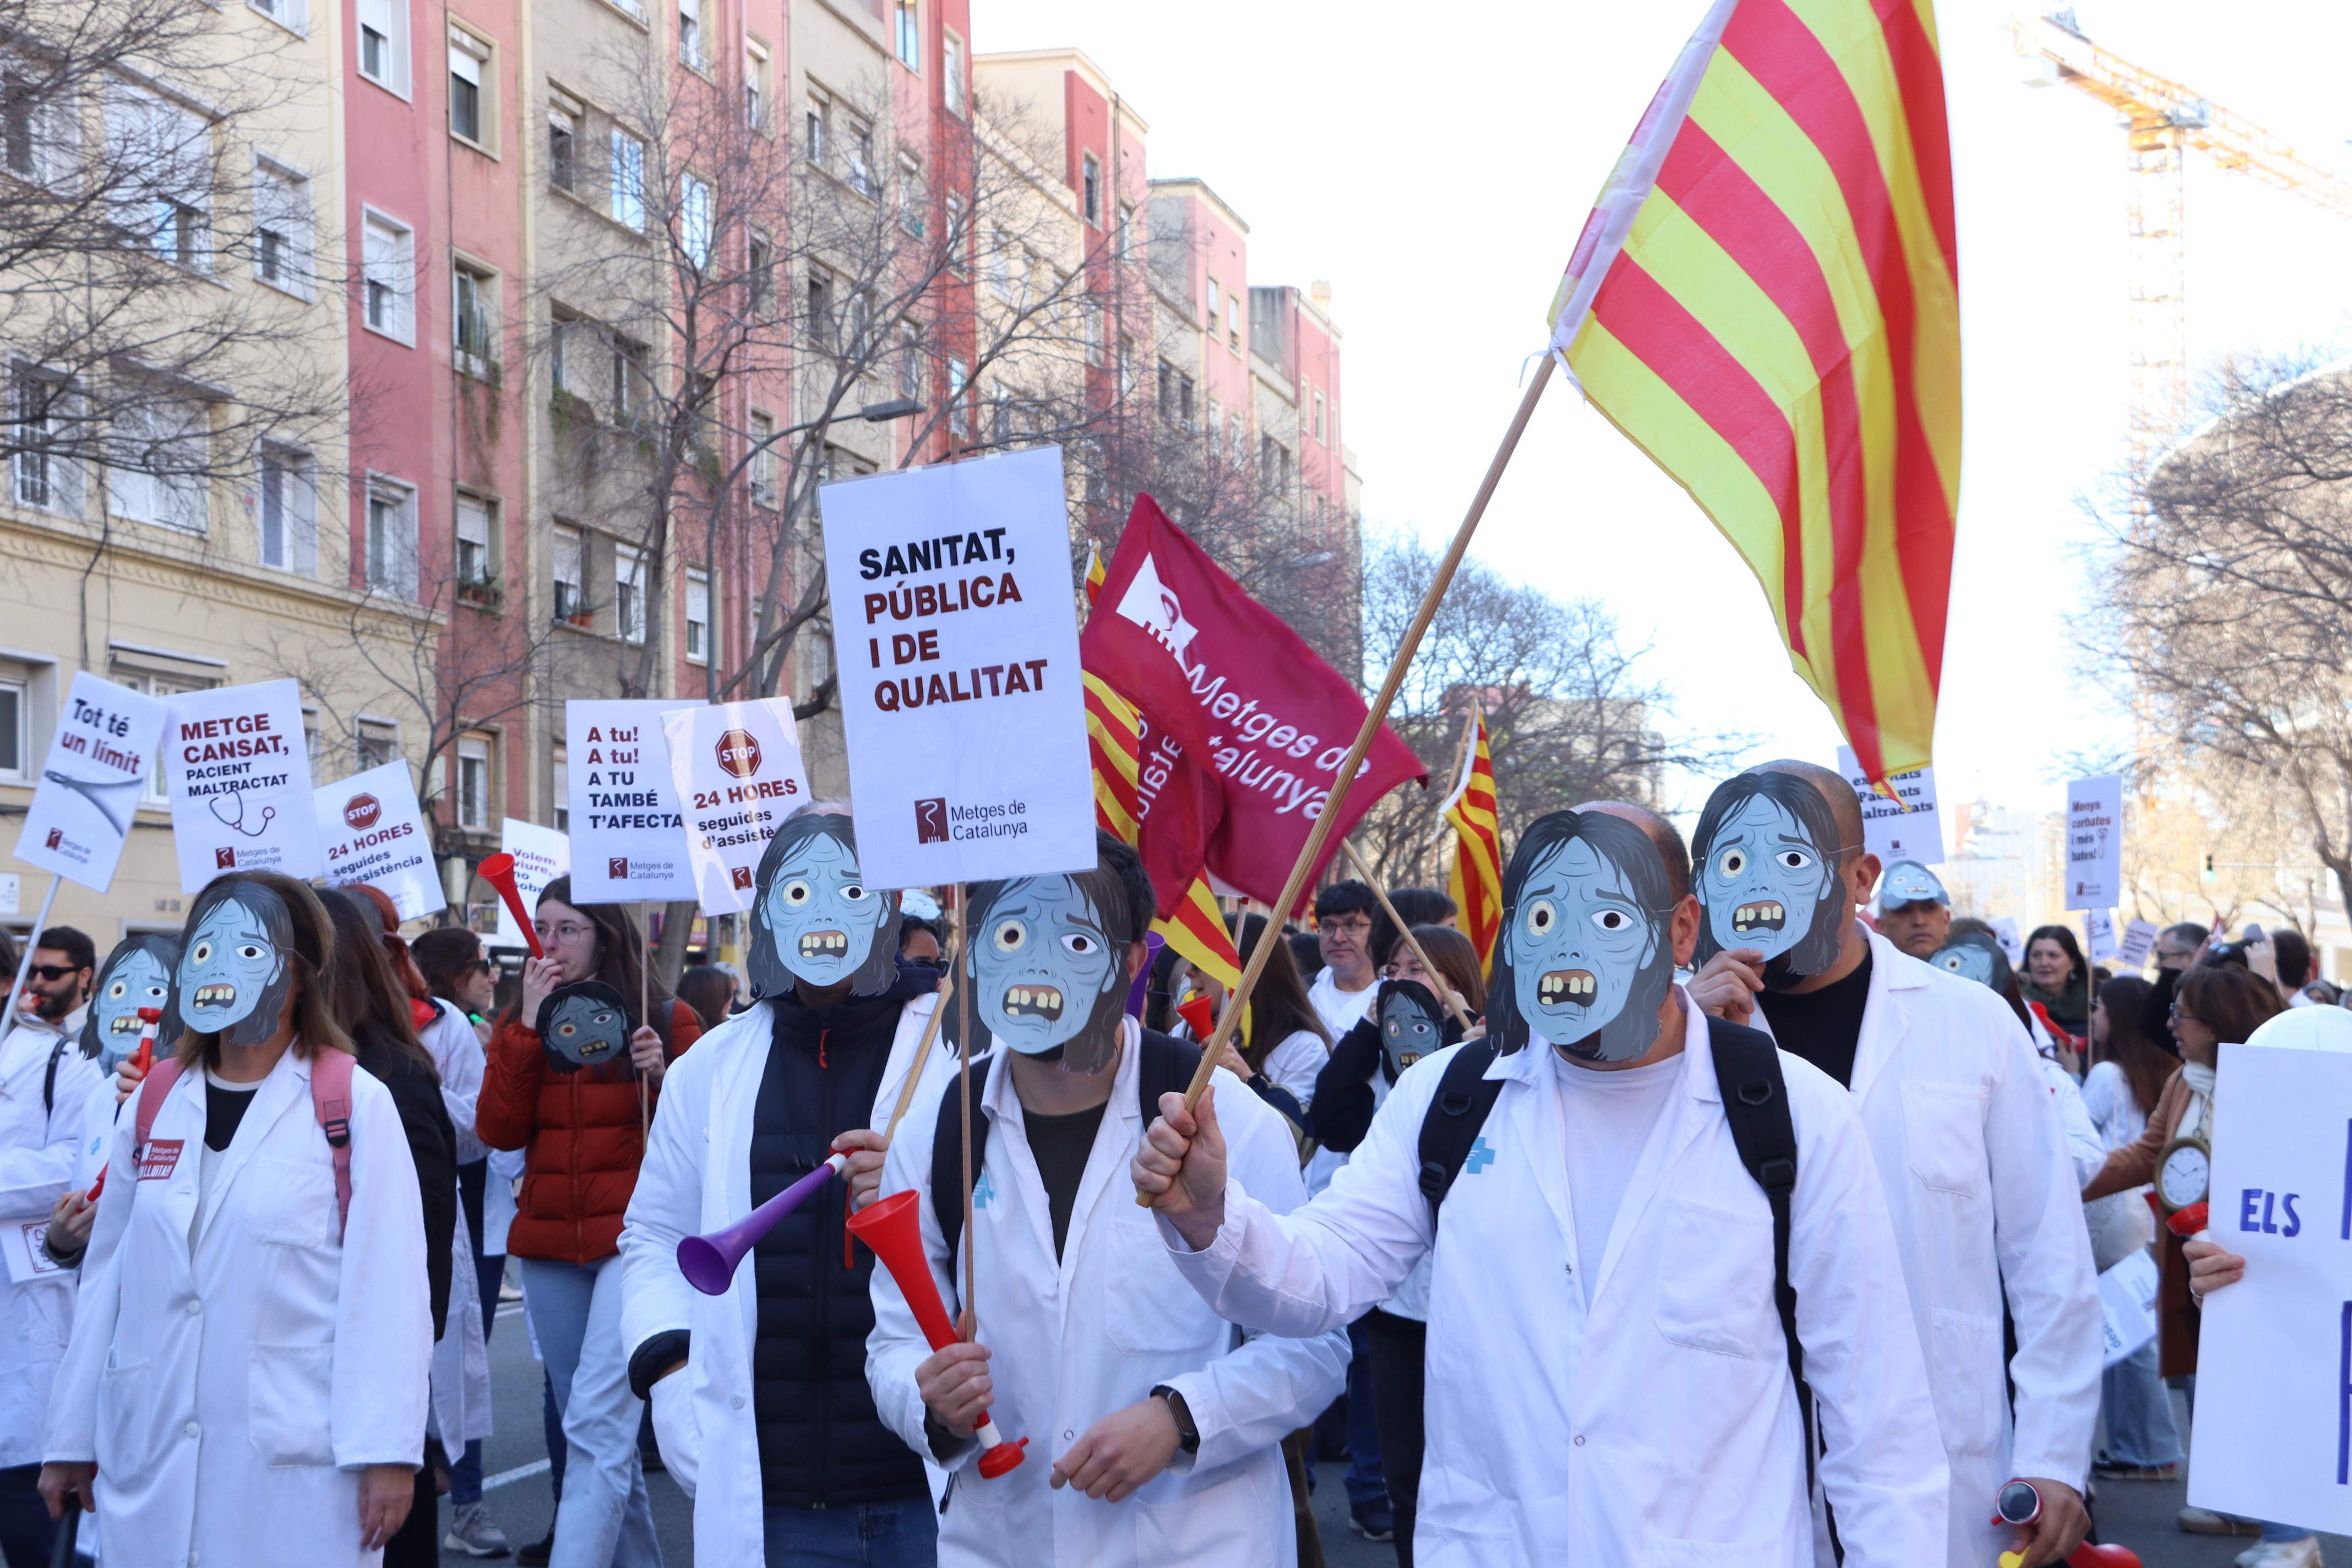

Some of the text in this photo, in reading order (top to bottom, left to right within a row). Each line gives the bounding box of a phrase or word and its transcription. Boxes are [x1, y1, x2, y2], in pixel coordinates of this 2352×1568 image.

[859, 527, 1015, 580] SANITAT,
[863, 571, 1022, 624] PÚBLICA
[869, 629, 940, 668] I DE
[874, 658, 1048, 712] QUALITAT
[72, 698, 131, 737] Tot té
[1188, 663, 1320, 758] Metges
[181, 713, 270, 741] METGE
[587, 726, 639, 742] A tu!
[61, 731, 141, 775] un límit
[183, 735, 289, 764] CANSAT,
[587, 748, 639, 764] A tu!
[722, 746, 756, 762] STOP
[186, 762, 252, 780] PACIENT
[588, 771, 634, 786] A TU
[188, 774, 288, 797] MALTRACTAT
[693, 778, 798, 809] 24 HORES
[589, 789, 658, 808] TAMBÉ
[2072, 800, 2100, 813] Menys
[348, 803, 376, 820] STOP
[698, 810, 772, 831] seguides
[951, 799, 1026, 822] Metges de
[589, 814, 683, 829] T'AFECTA
[954, 821, 1027, 841] Catalunya
[2071, 815, 2111, 829] corbates
[328, 822, 413, 861] 24 HORES
[702, 825, 778, 850] d'assistè
[2071, 831, 2094, 845] i més
[236, 846, 281, 858] Metges de
[238, 856, 282, 867] Catalunya
[513, 847, 556, 866] Volem
[2071, 848, 2097, 862] bates!
[333, 850, 391, 877] seguides
[630, 862, 661, 871] Metges
[630, 871, 673, 880] Catalunya
[2240, 1188, 2300, 1238] ELS
